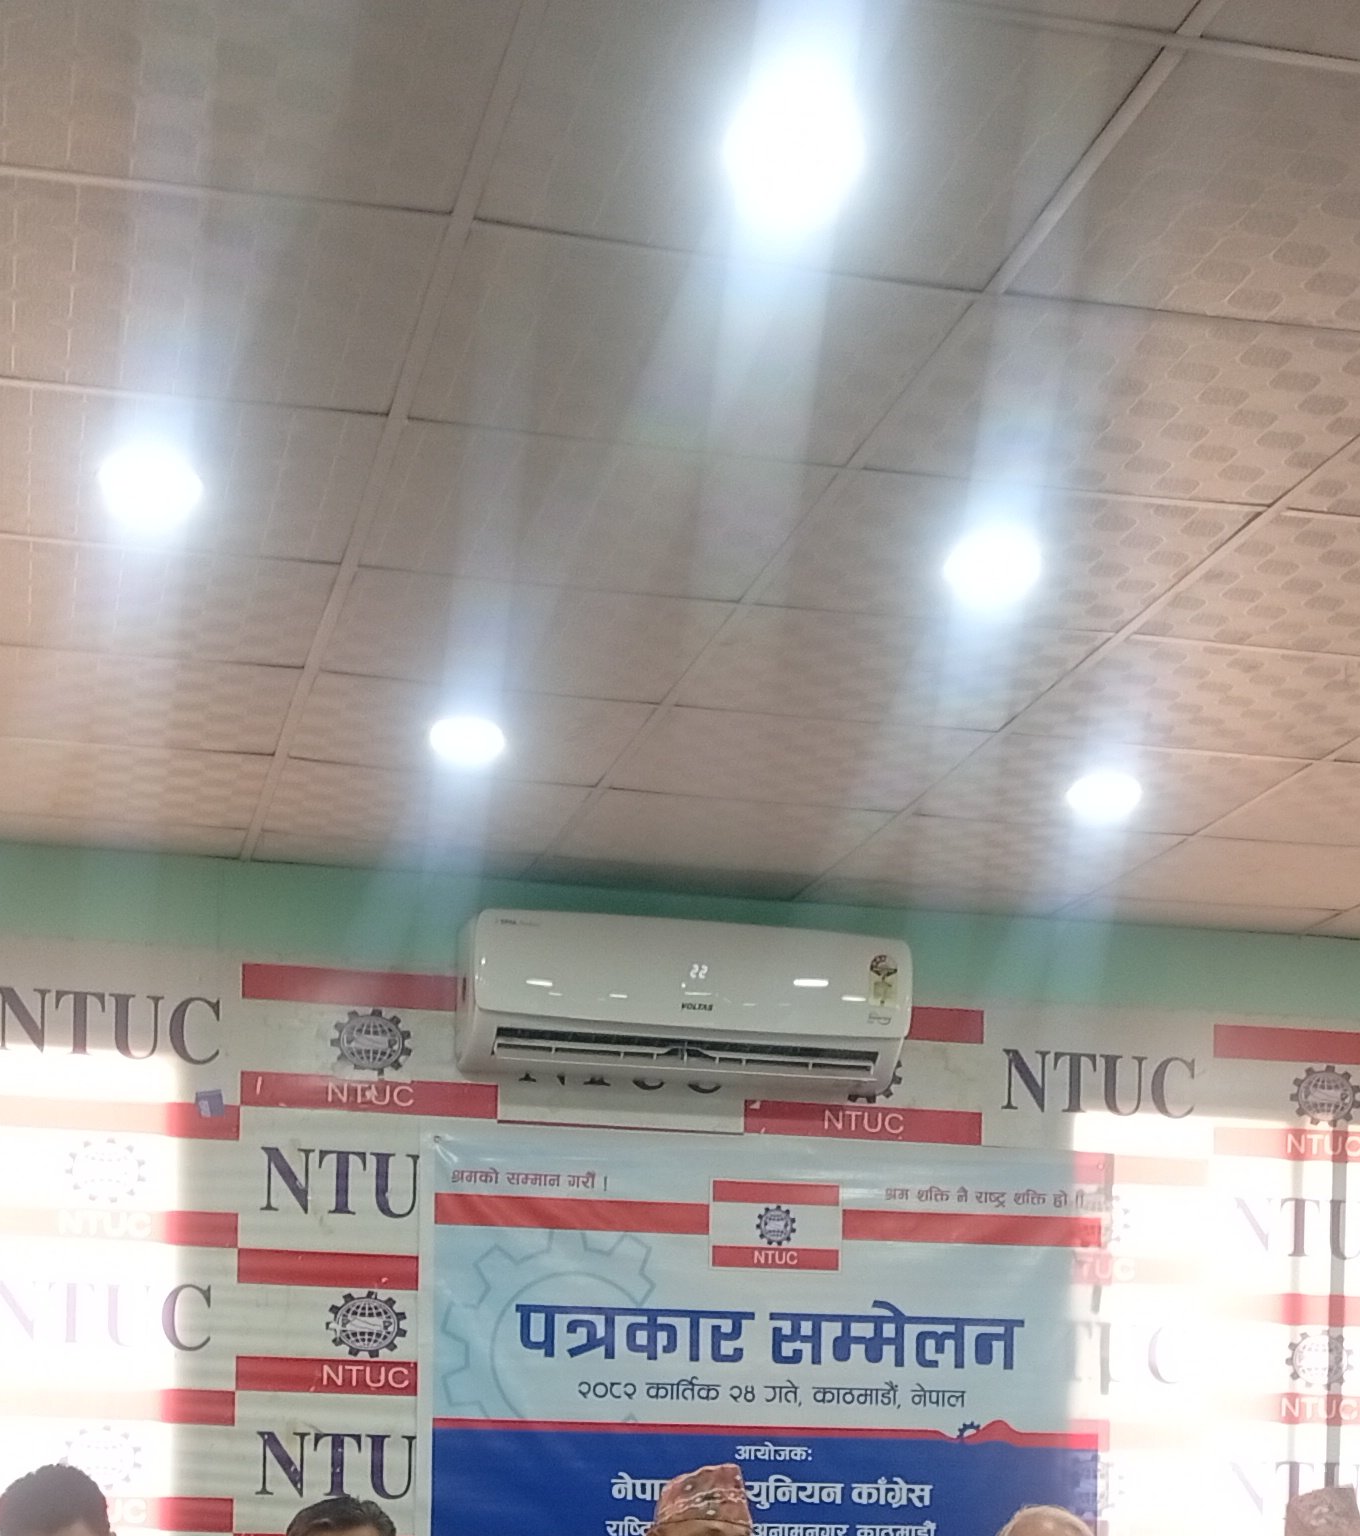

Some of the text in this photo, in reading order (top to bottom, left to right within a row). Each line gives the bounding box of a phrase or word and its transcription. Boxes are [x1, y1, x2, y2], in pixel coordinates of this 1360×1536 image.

[690, 964, 708, 979] 22
[681, 1003, 713, 1011] VOLTAS
[327, 1082, 414, 1107] NTUC
[1001, 1048, 1196, 1119] NTUC
[824, 1110, 904, 1134] NTUC
[259, 1146, 419, 1218] NTU
[754, 1251, 798, 1264] NTUC
[515, 1299, 1025, 1372] पत्रकार सम्मेलन
[321, 1364, 409, 1388] NTUC
[578, 1381, 636, 1399] २०८२
[646, 1376, 721, 1401] कार्तिक
[729, 1385, 756, 1403] २४
[764, 1379, 802, 1407] गते,
[910, 1383, 966, 1408] नेपाल
[1281, 1398, 1359, 1420] NTUC
[255, 1431, 416, 1499] NTU
[611, 1472, 666, 1500] नेपा
